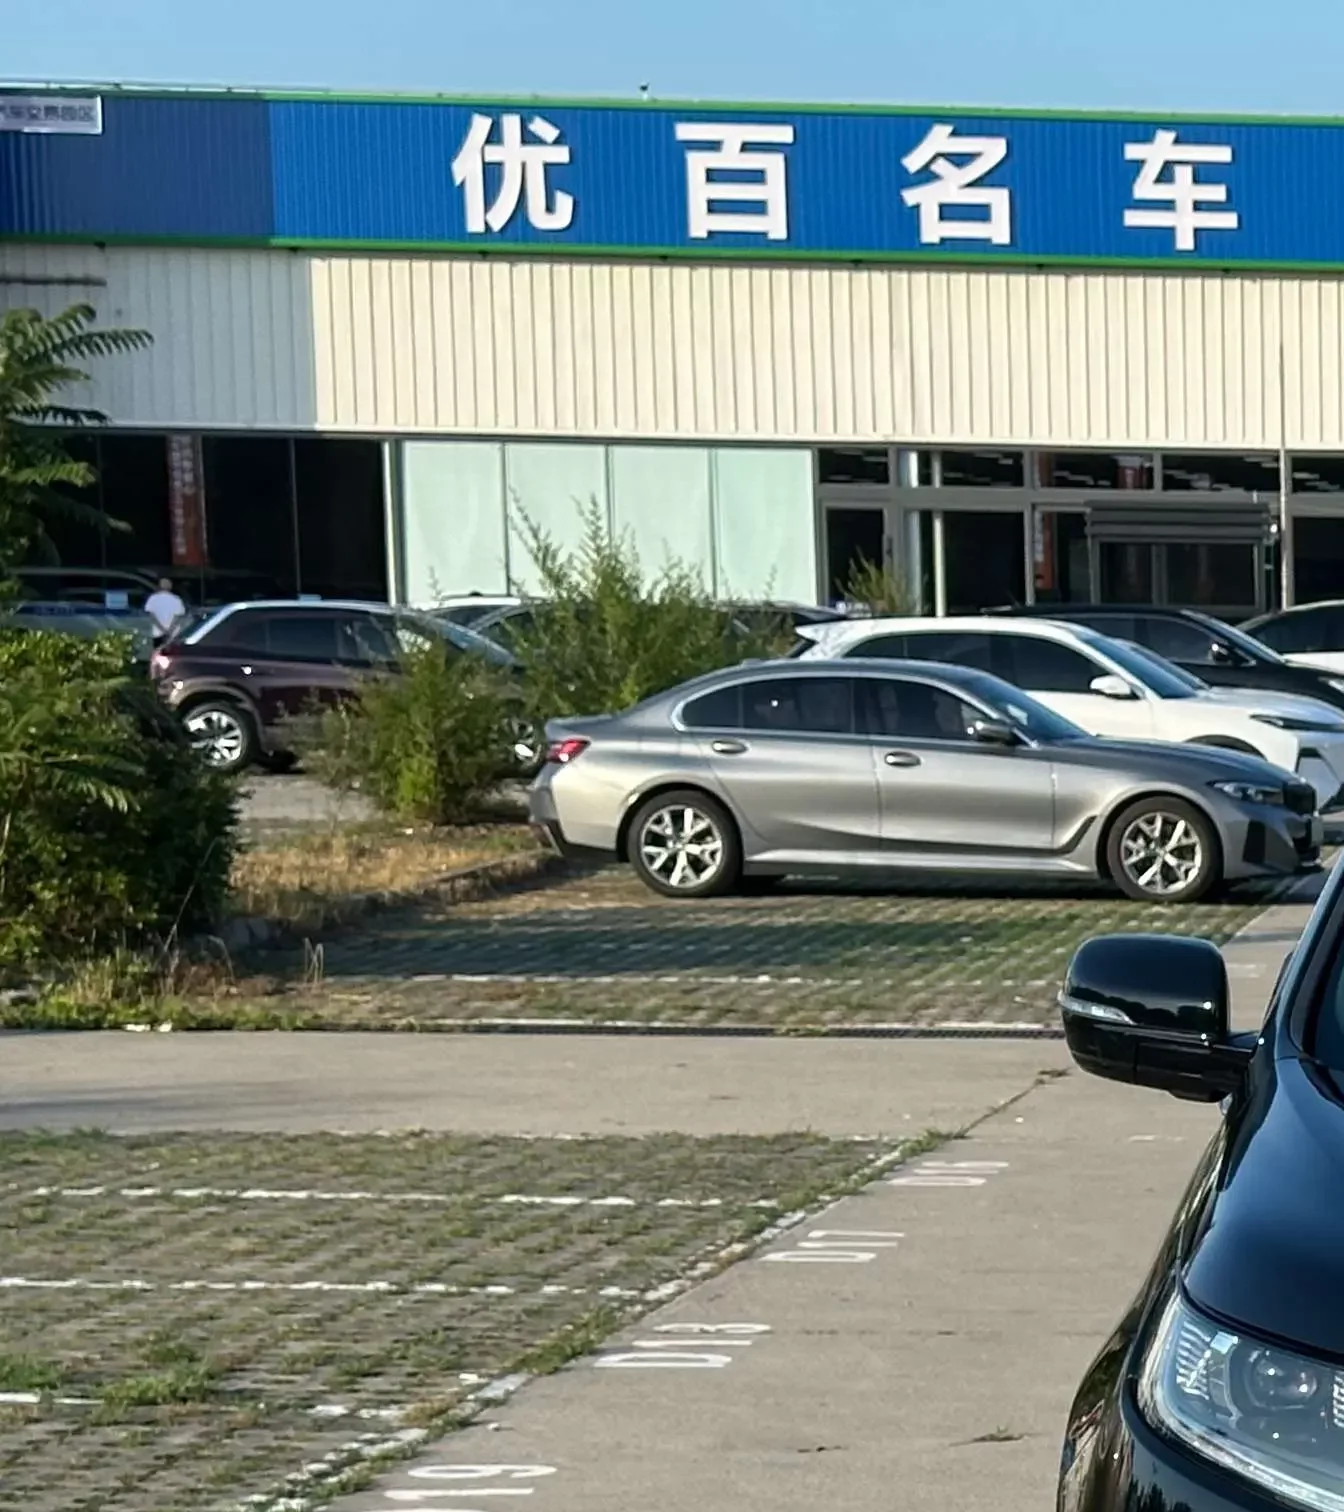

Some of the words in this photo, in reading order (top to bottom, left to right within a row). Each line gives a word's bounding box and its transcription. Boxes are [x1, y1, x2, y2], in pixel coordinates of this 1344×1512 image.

[452, 112, 1238, 250] 优百名车
[758, 1230, 904, 1262] D17
